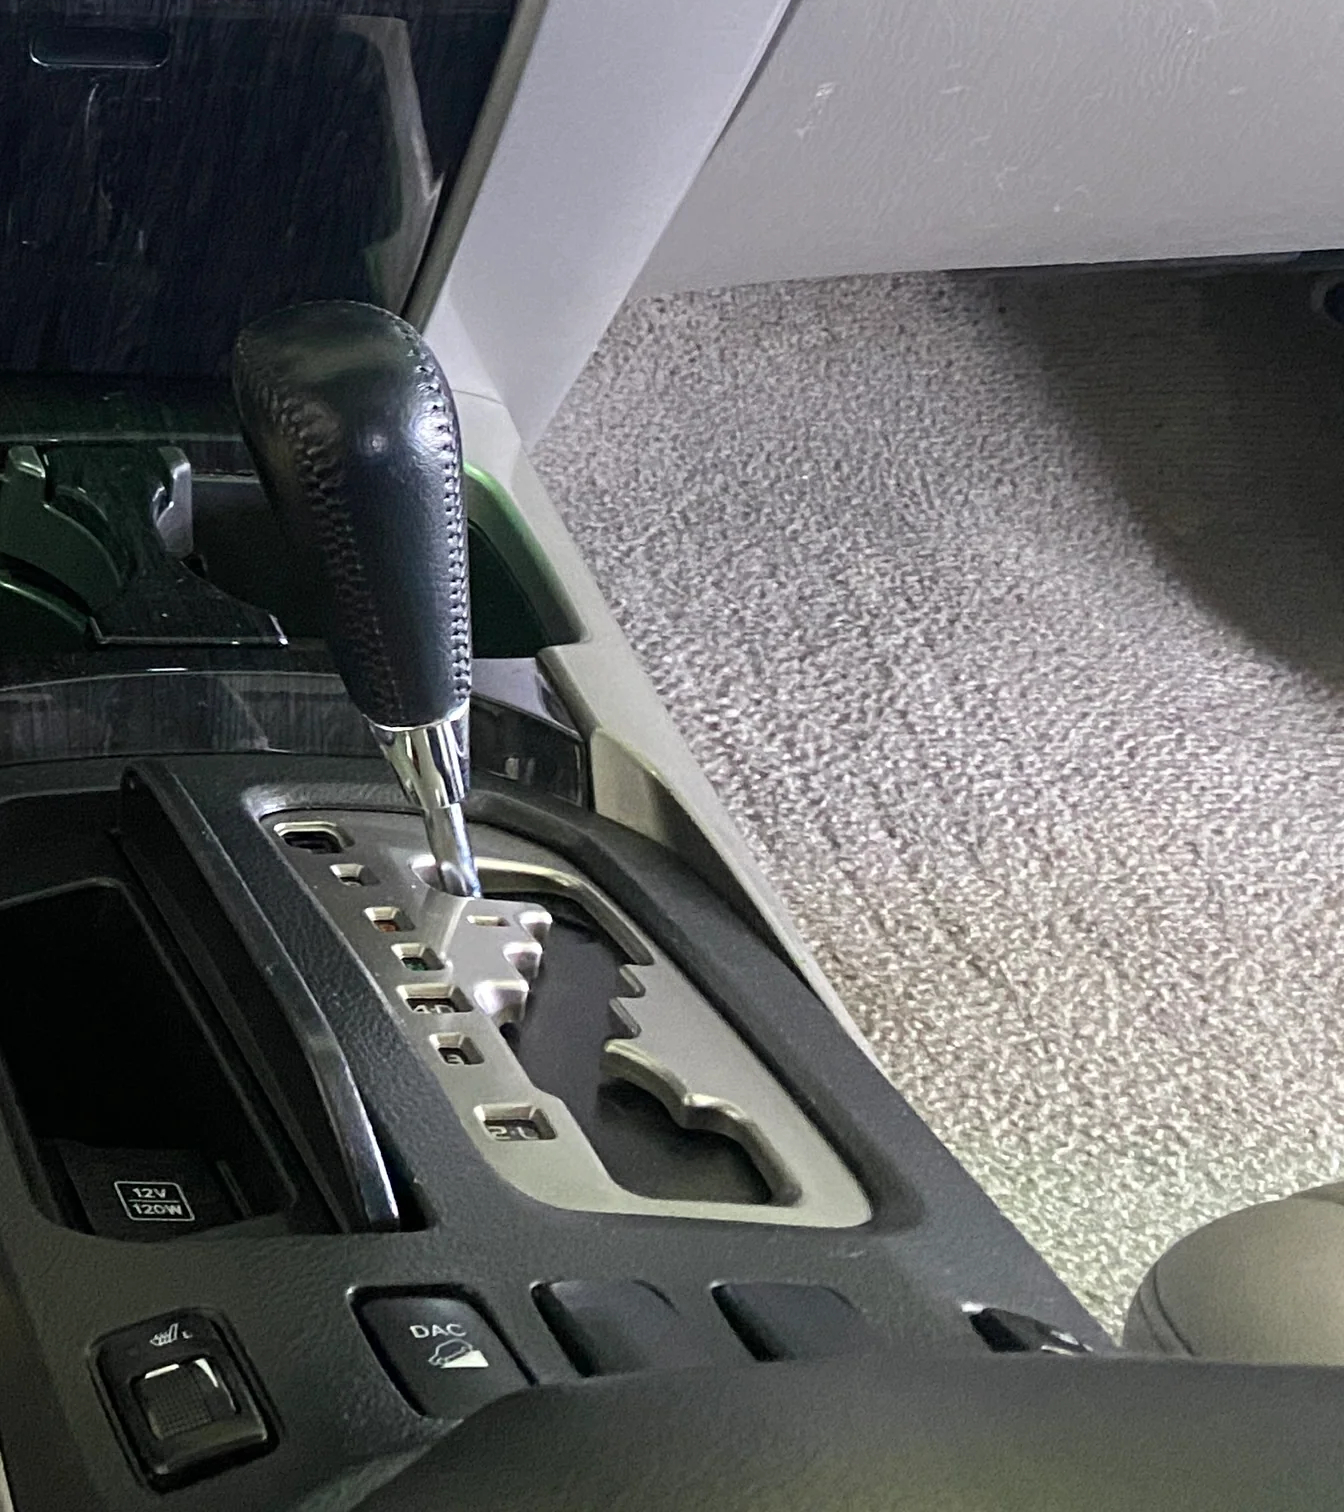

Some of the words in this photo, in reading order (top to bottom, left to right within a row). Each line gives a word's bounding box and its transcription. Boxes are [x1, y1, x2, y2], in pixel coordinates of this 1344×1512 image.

[132, 1188, 166, 1198] 12V
[133, 1203, 183, 1215] 120W
[409, 1322, 467, 1338] DAC
